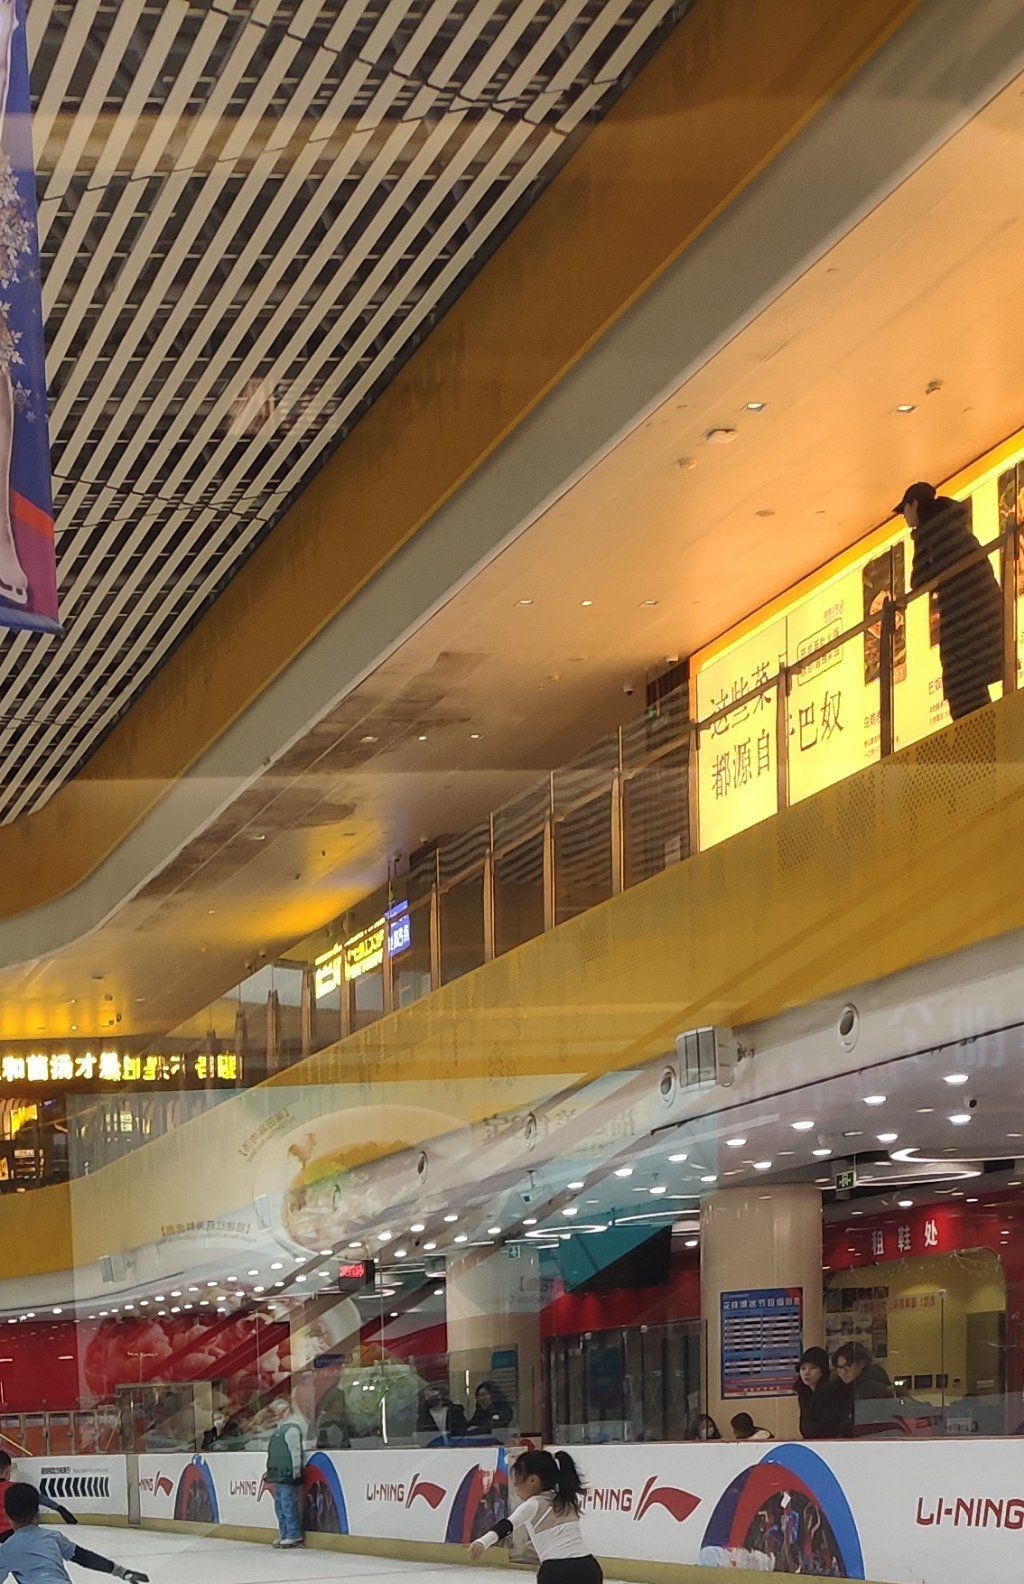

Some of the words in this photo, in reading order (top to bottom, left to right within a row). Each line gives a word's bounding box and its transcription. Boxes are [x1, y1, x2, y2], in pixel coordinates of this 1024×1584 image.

[230, 1479, 258, 1496] LI-NING
[366, 1482, 405, 1503] LI-NING
[916, 1497, 1024, 1530] LI-NING
